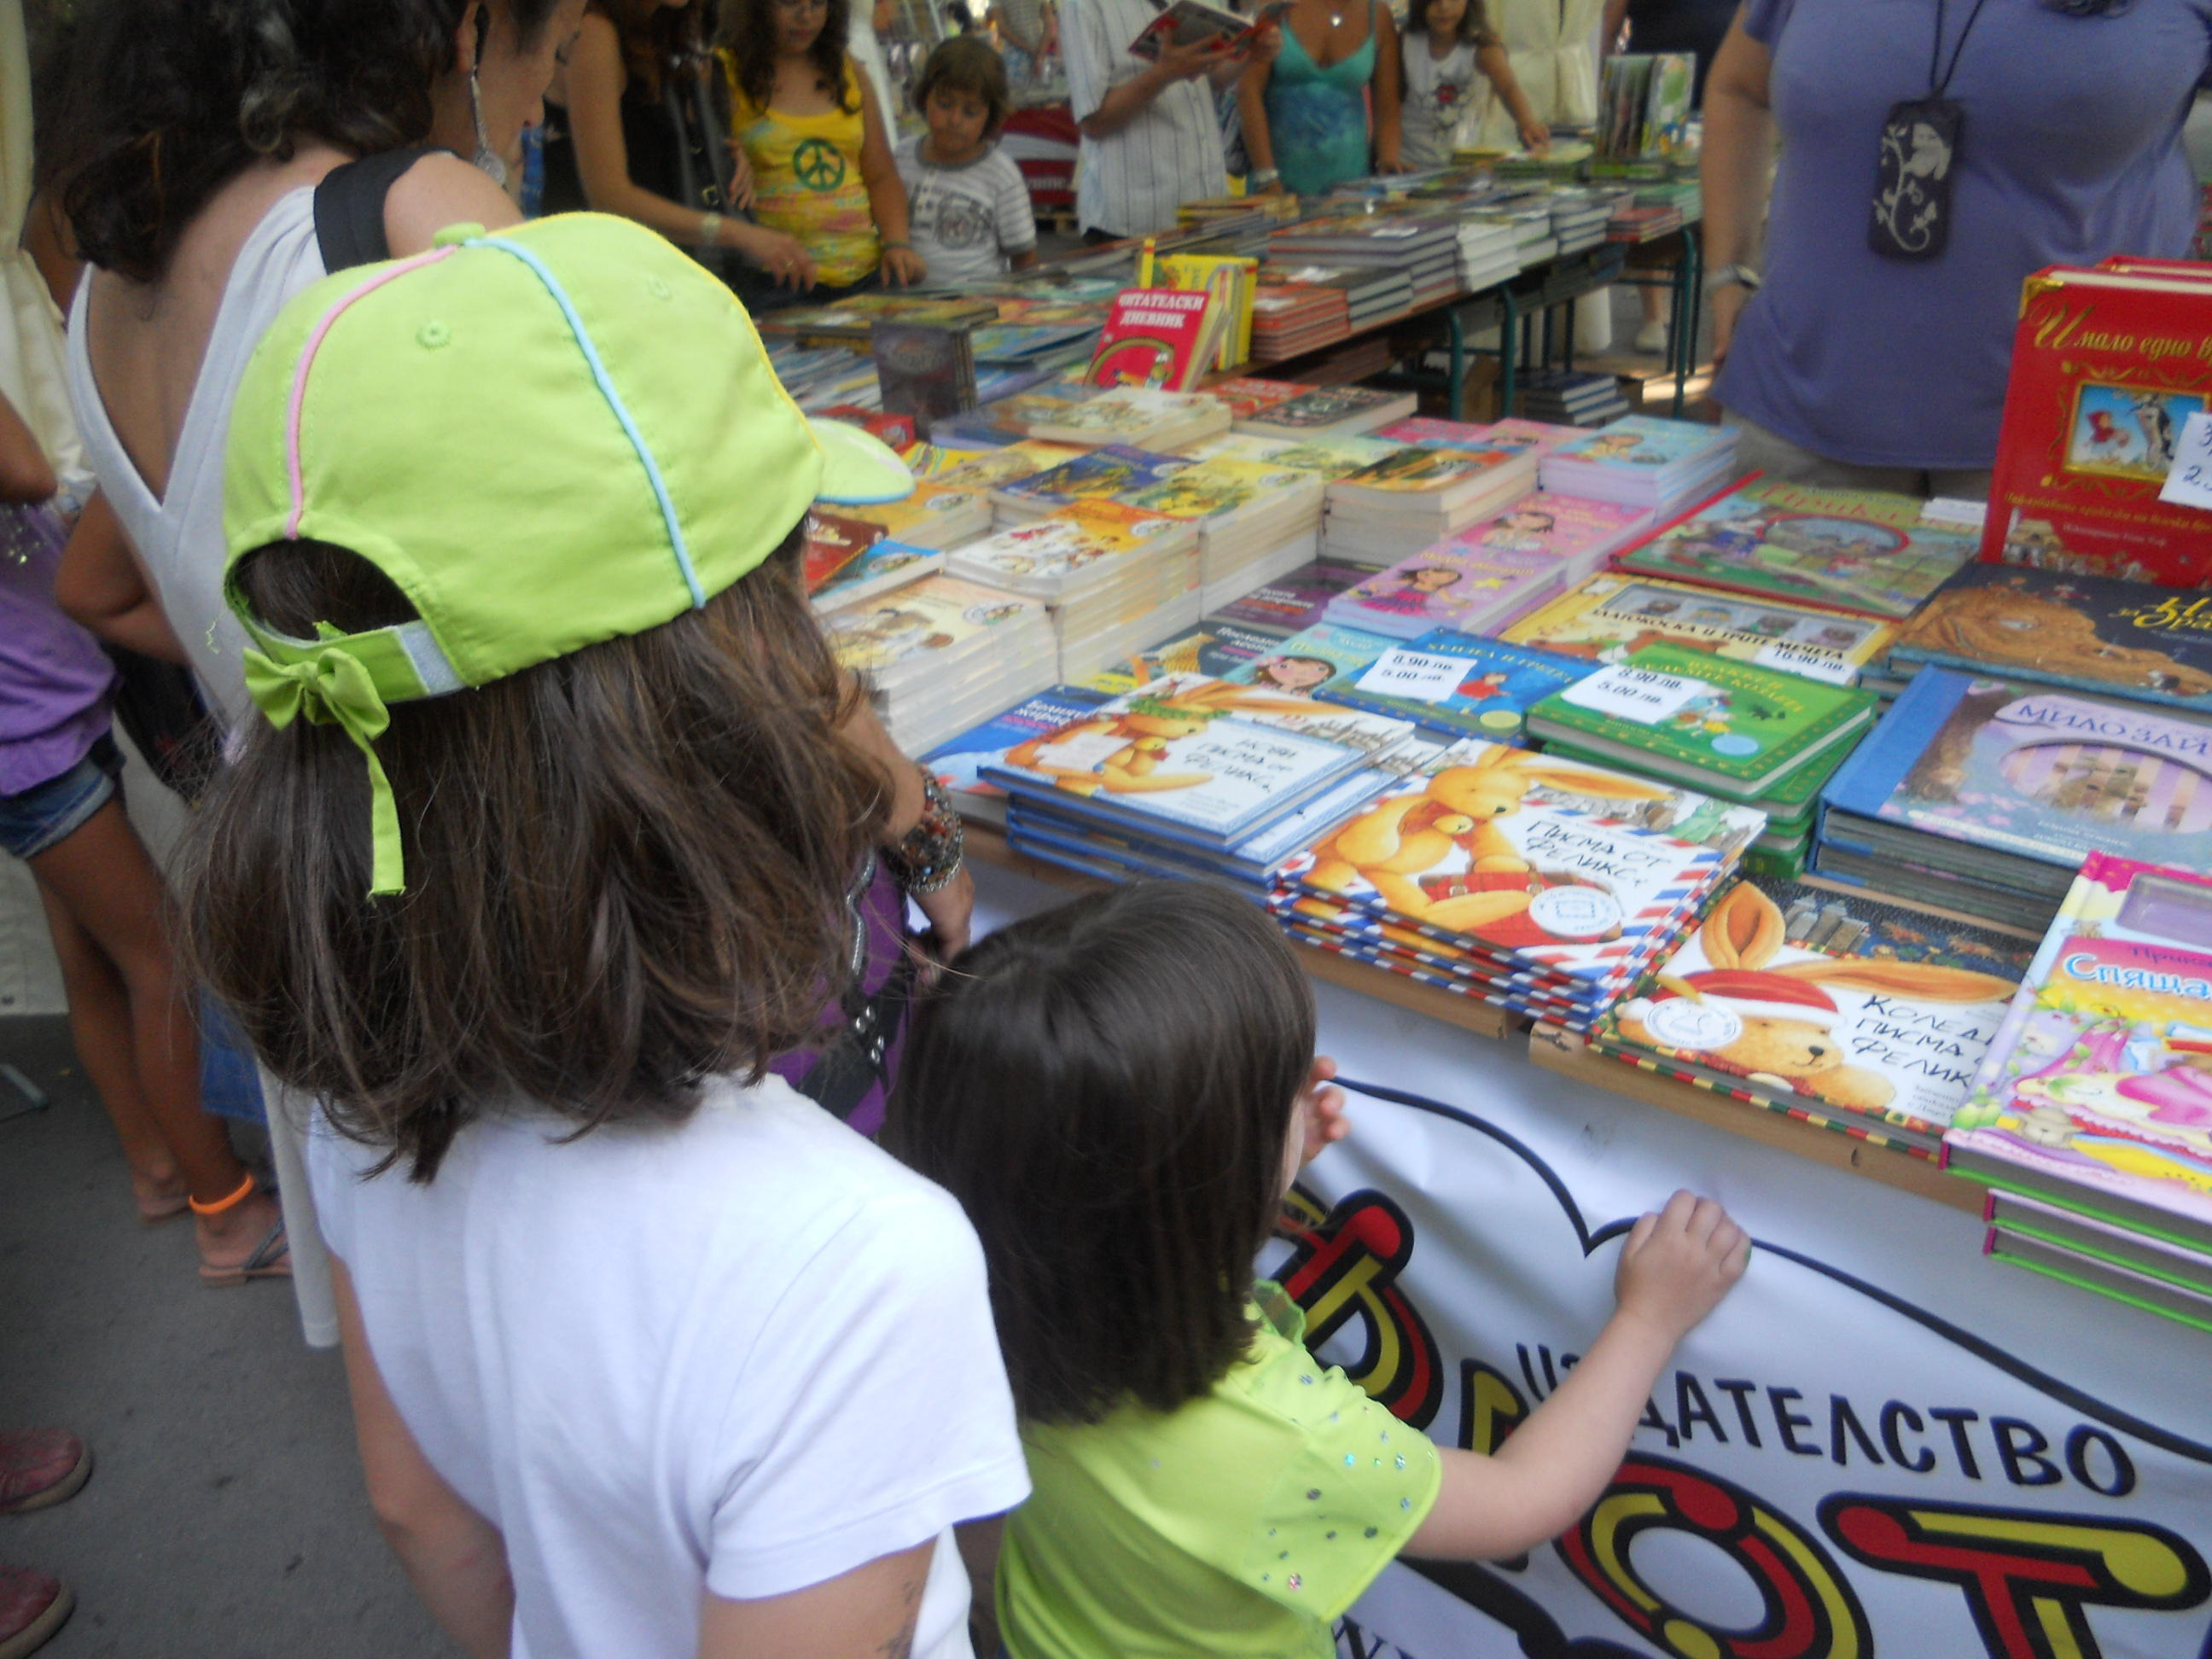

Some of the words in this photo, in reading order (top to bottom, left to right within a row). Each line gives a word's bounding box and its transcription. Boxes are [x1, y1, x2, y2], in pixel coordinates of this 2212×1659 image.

[1119, 293, 1205, 311] ЧИТАТЕЛСКИ
[1120, 310, 1186, 329] ДНЕВНИК
[2033, 301, 2134, 352] Имало
[2139, 336, 2192, 363] едно
[1774, 640, 1844, 660] МЕЧЕТА
[2018, 704, 2126, 736] МИЛО
[1526, 820, 1615, 854] ПИСМА
[1622, 851, 1672, 868] ОТ
[1526, 836, 1639, 881] ФЕЛИКС
[2064, 952, 2211, 1001] Спяща
[1855, 1018, 1965, 1057] ПИСМА
[1861, 994, 1995, 1047] КОЛЕД
[1851, 1036, 1972, 1088] ФЕЛИК
[1515, 1342, 2138, 1499] ИДАТЕЛСТВО
